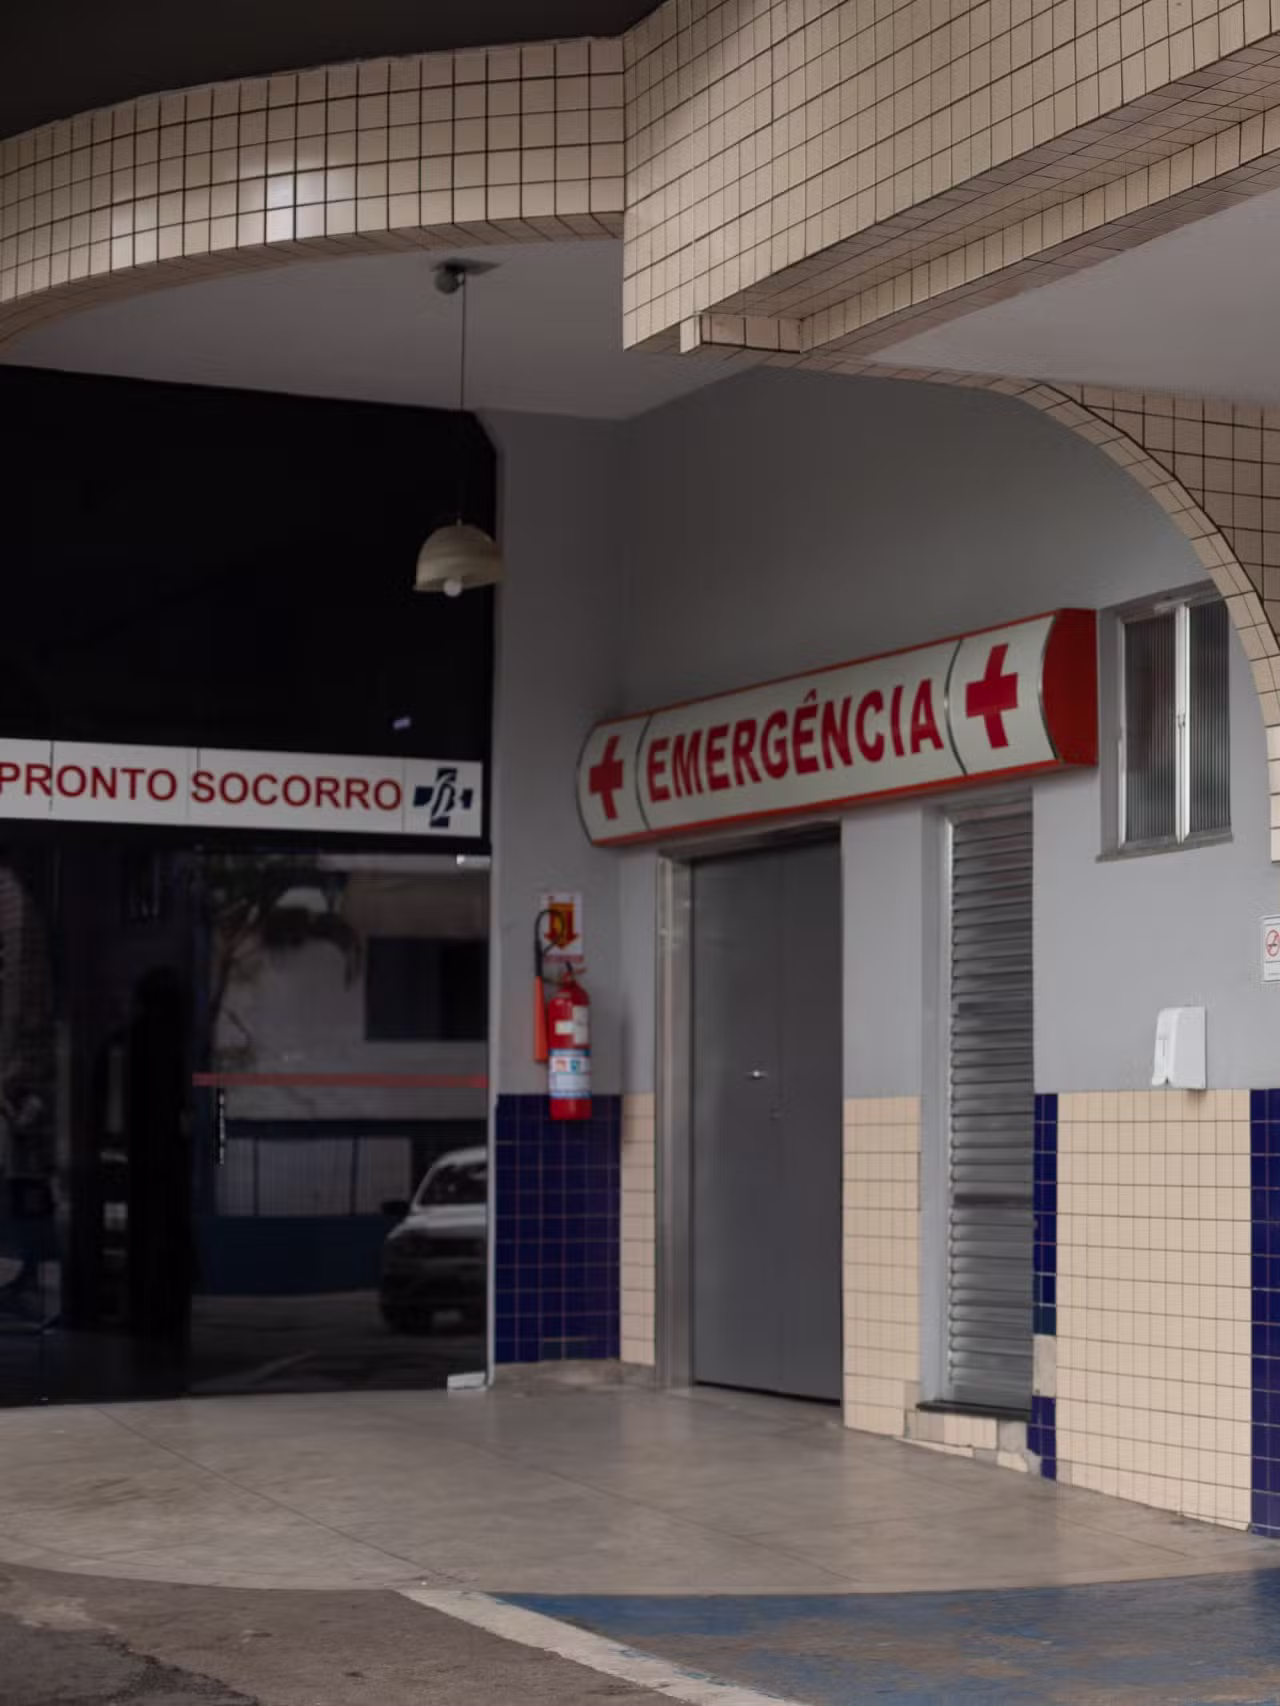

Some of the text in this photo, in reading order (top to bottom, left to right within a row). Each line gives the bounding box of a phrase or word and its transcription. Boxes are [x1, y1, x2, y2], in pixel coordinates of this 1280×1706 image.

[646, 679, 944, 802] EMERGÊNCIA
[0, 762, 403, 811] PRONTO SOCORRO
